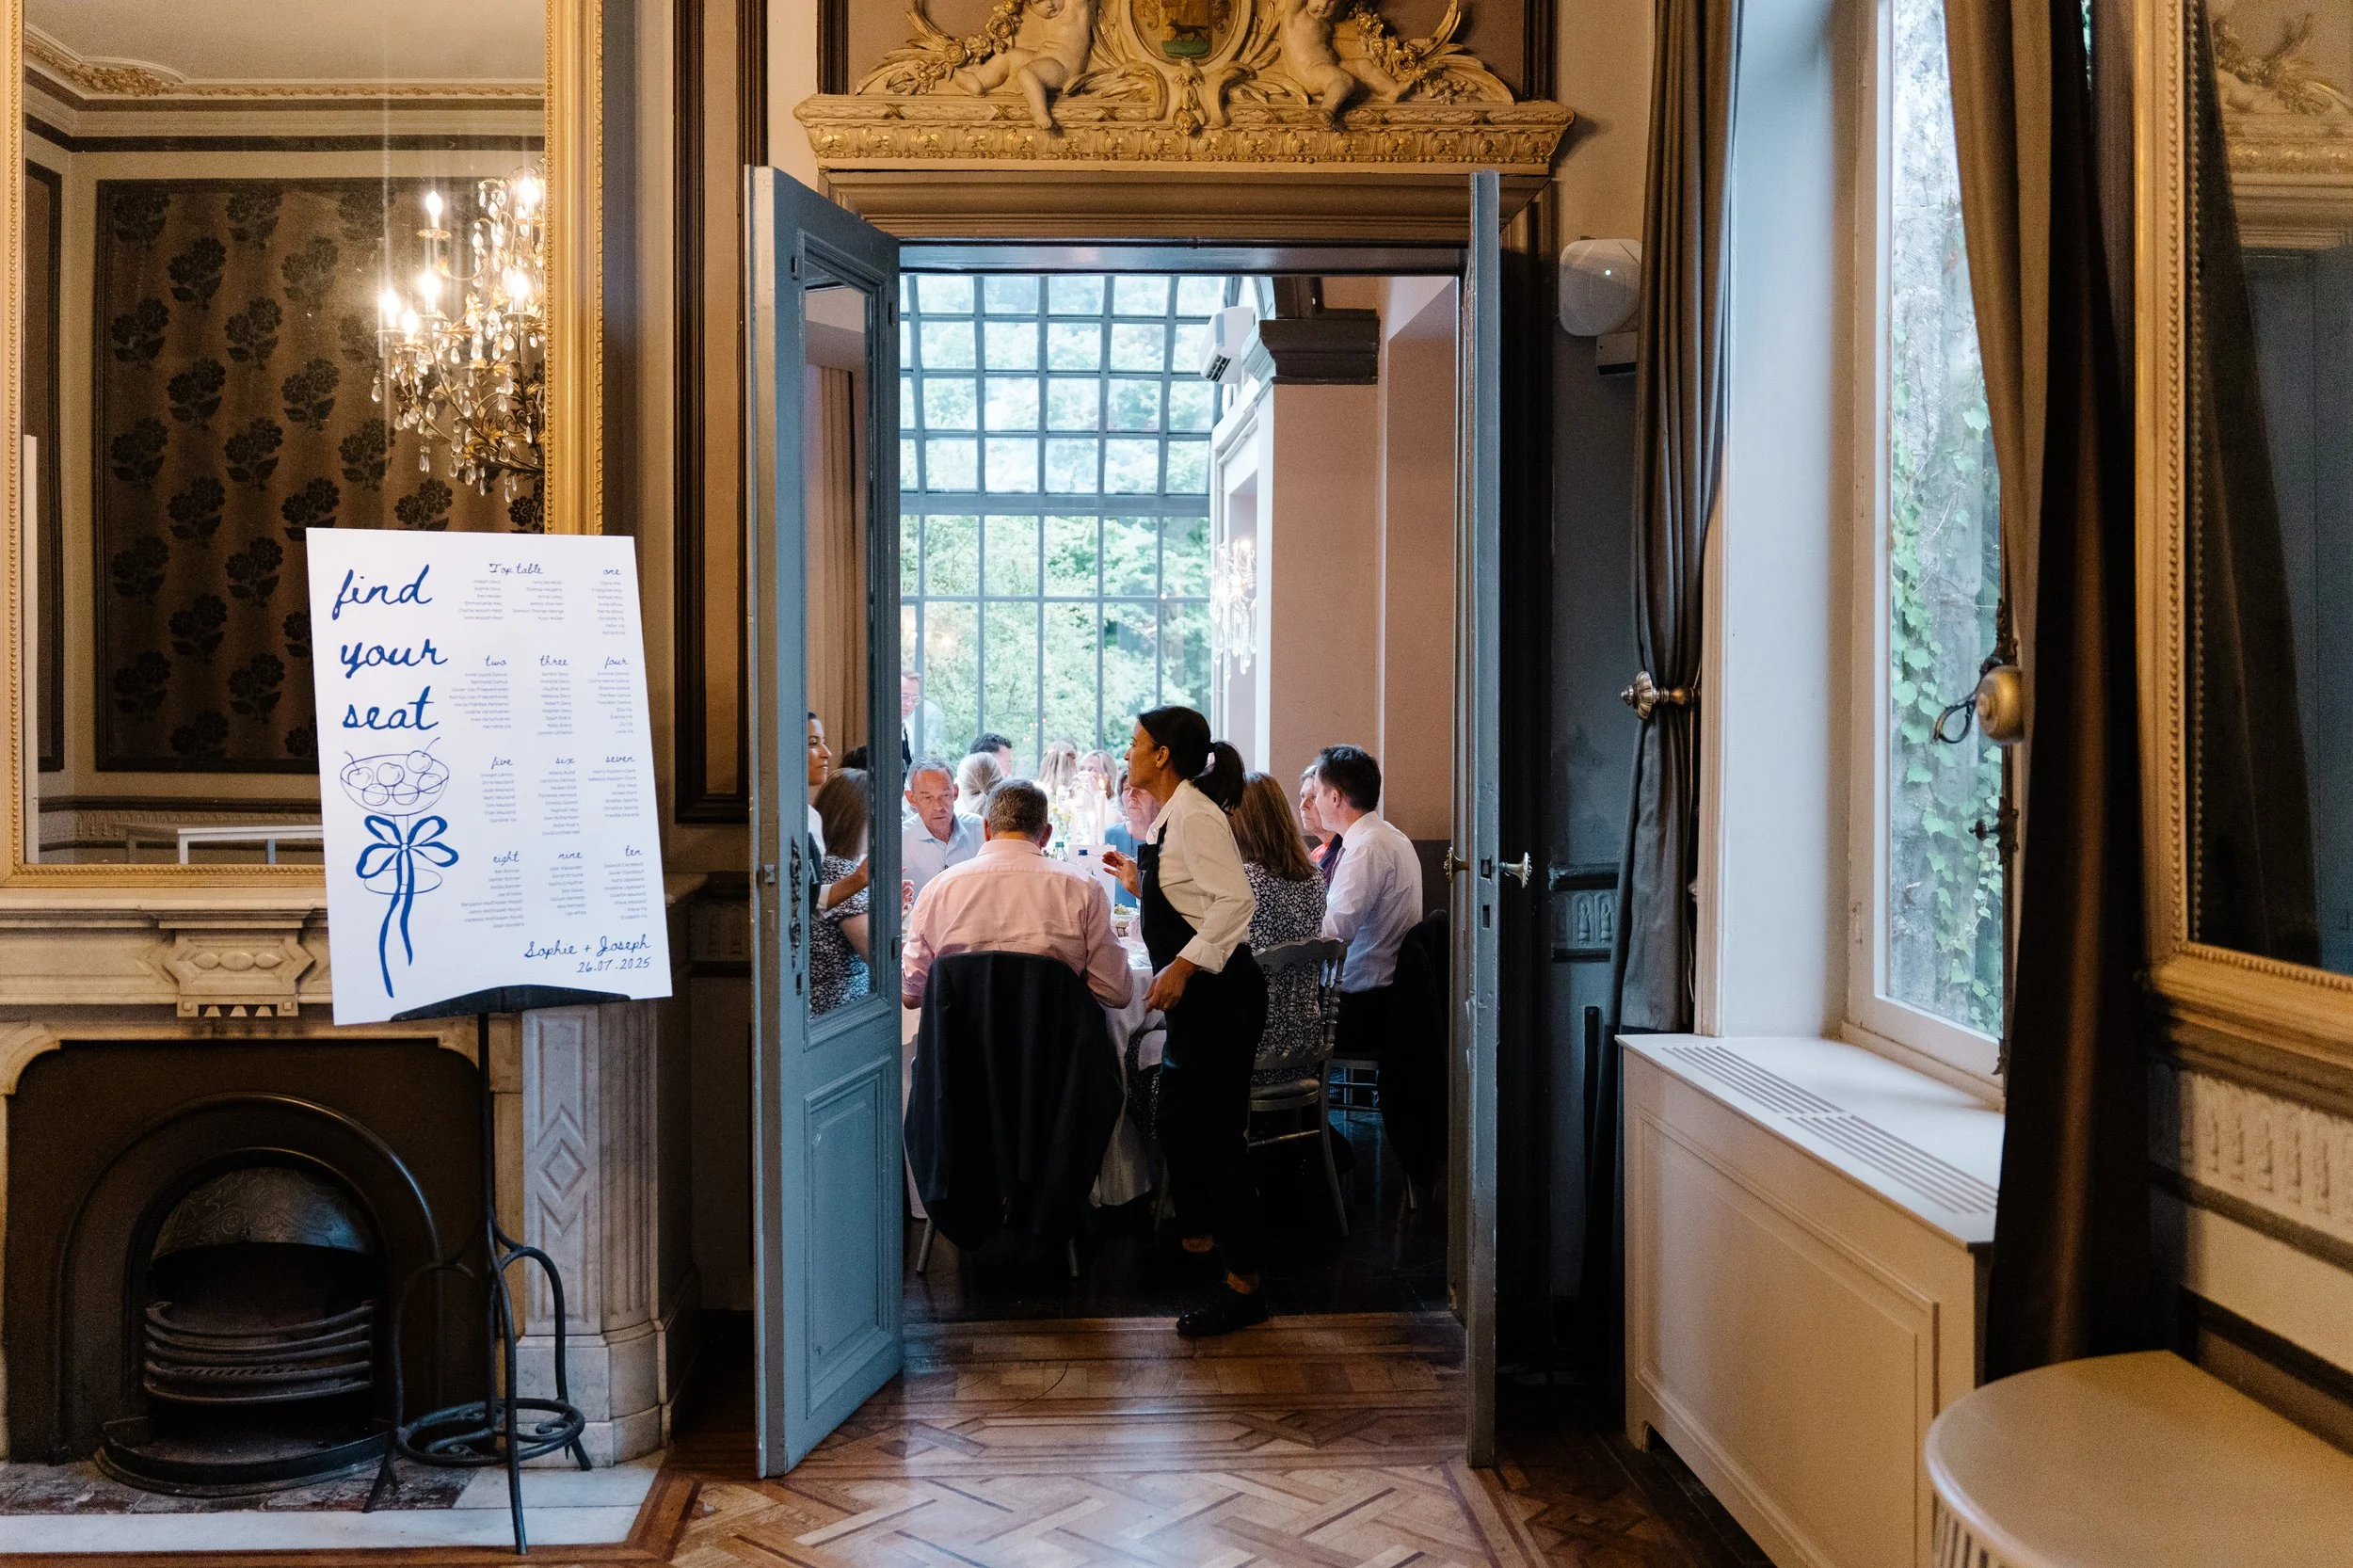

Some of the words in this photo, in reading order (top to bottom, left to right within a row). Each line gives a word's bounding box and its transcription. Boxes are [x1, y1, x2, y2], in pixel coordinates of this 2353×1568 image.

[488, 563, 514, 576] Top
[516, 562, 544, 575] table
[331, 564, 433, 620] find
[341, 638, 448, 679] your
[485, 654, 507, 667] two
[539, 654, 569, 666] three
[603, 656, 628, 669] four
[342, 685, 439, 730] seat
[490, 756, 513, 771] five
[554, 757, 576, 765] six
[557, 852, 584, 860] nine
[624, 844, 643, 857] ten
[492, 850, 520, 867] eight
[524, 939, 577, 959] Sophie
[596, 934, 651, 958] Joseph
[576, 956, 651, 973] 26.07.2025
